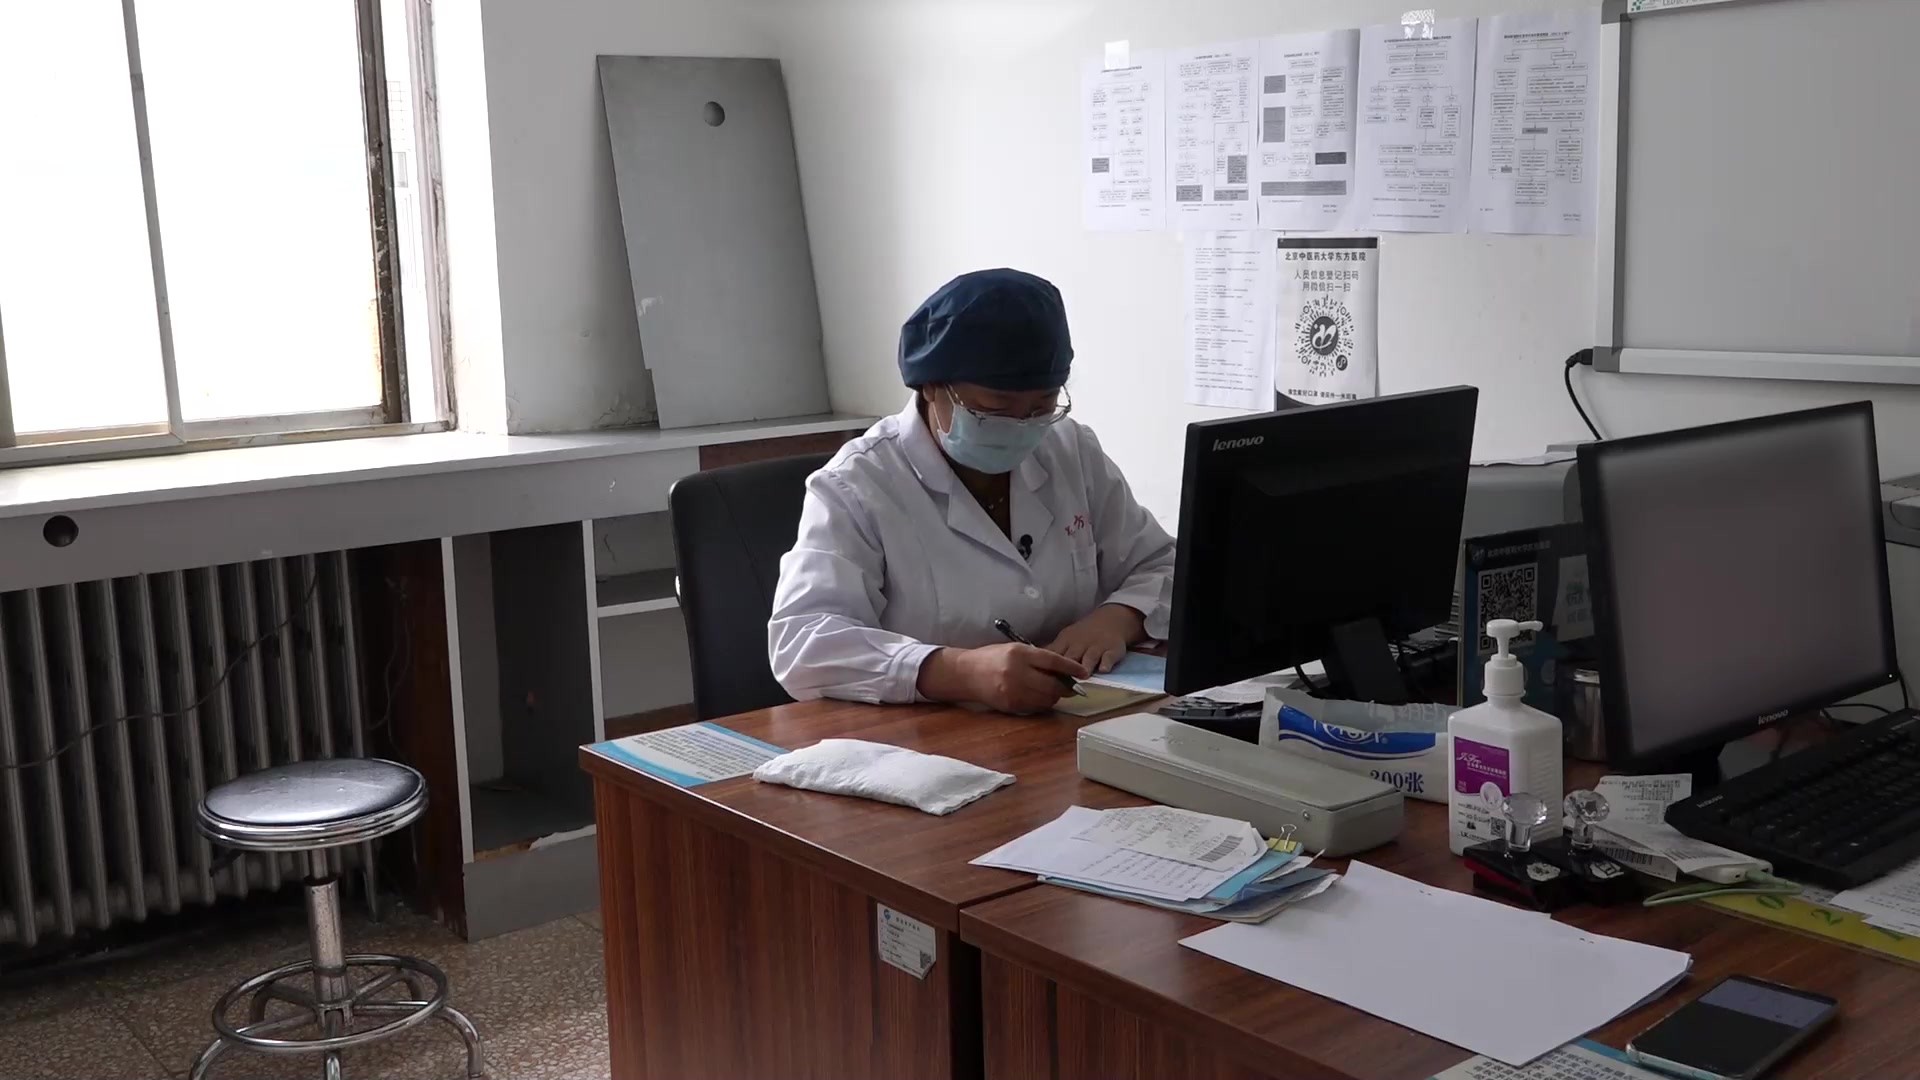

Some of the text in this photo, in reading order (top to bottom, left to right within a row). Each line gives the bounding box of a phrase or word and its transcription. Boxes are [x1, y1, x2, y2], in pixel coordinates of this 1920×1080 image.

[1285, 251, 1366, 261] 北京中医药大学东方医院
[1294, 269, 1359, 280] 人员信息登记扫码
[1302, 281, 1351, 292] 用微信扫一扫
[1212, 435, 1264, 452] lenovo
[1758, 709, 1789, 725] lenovo
